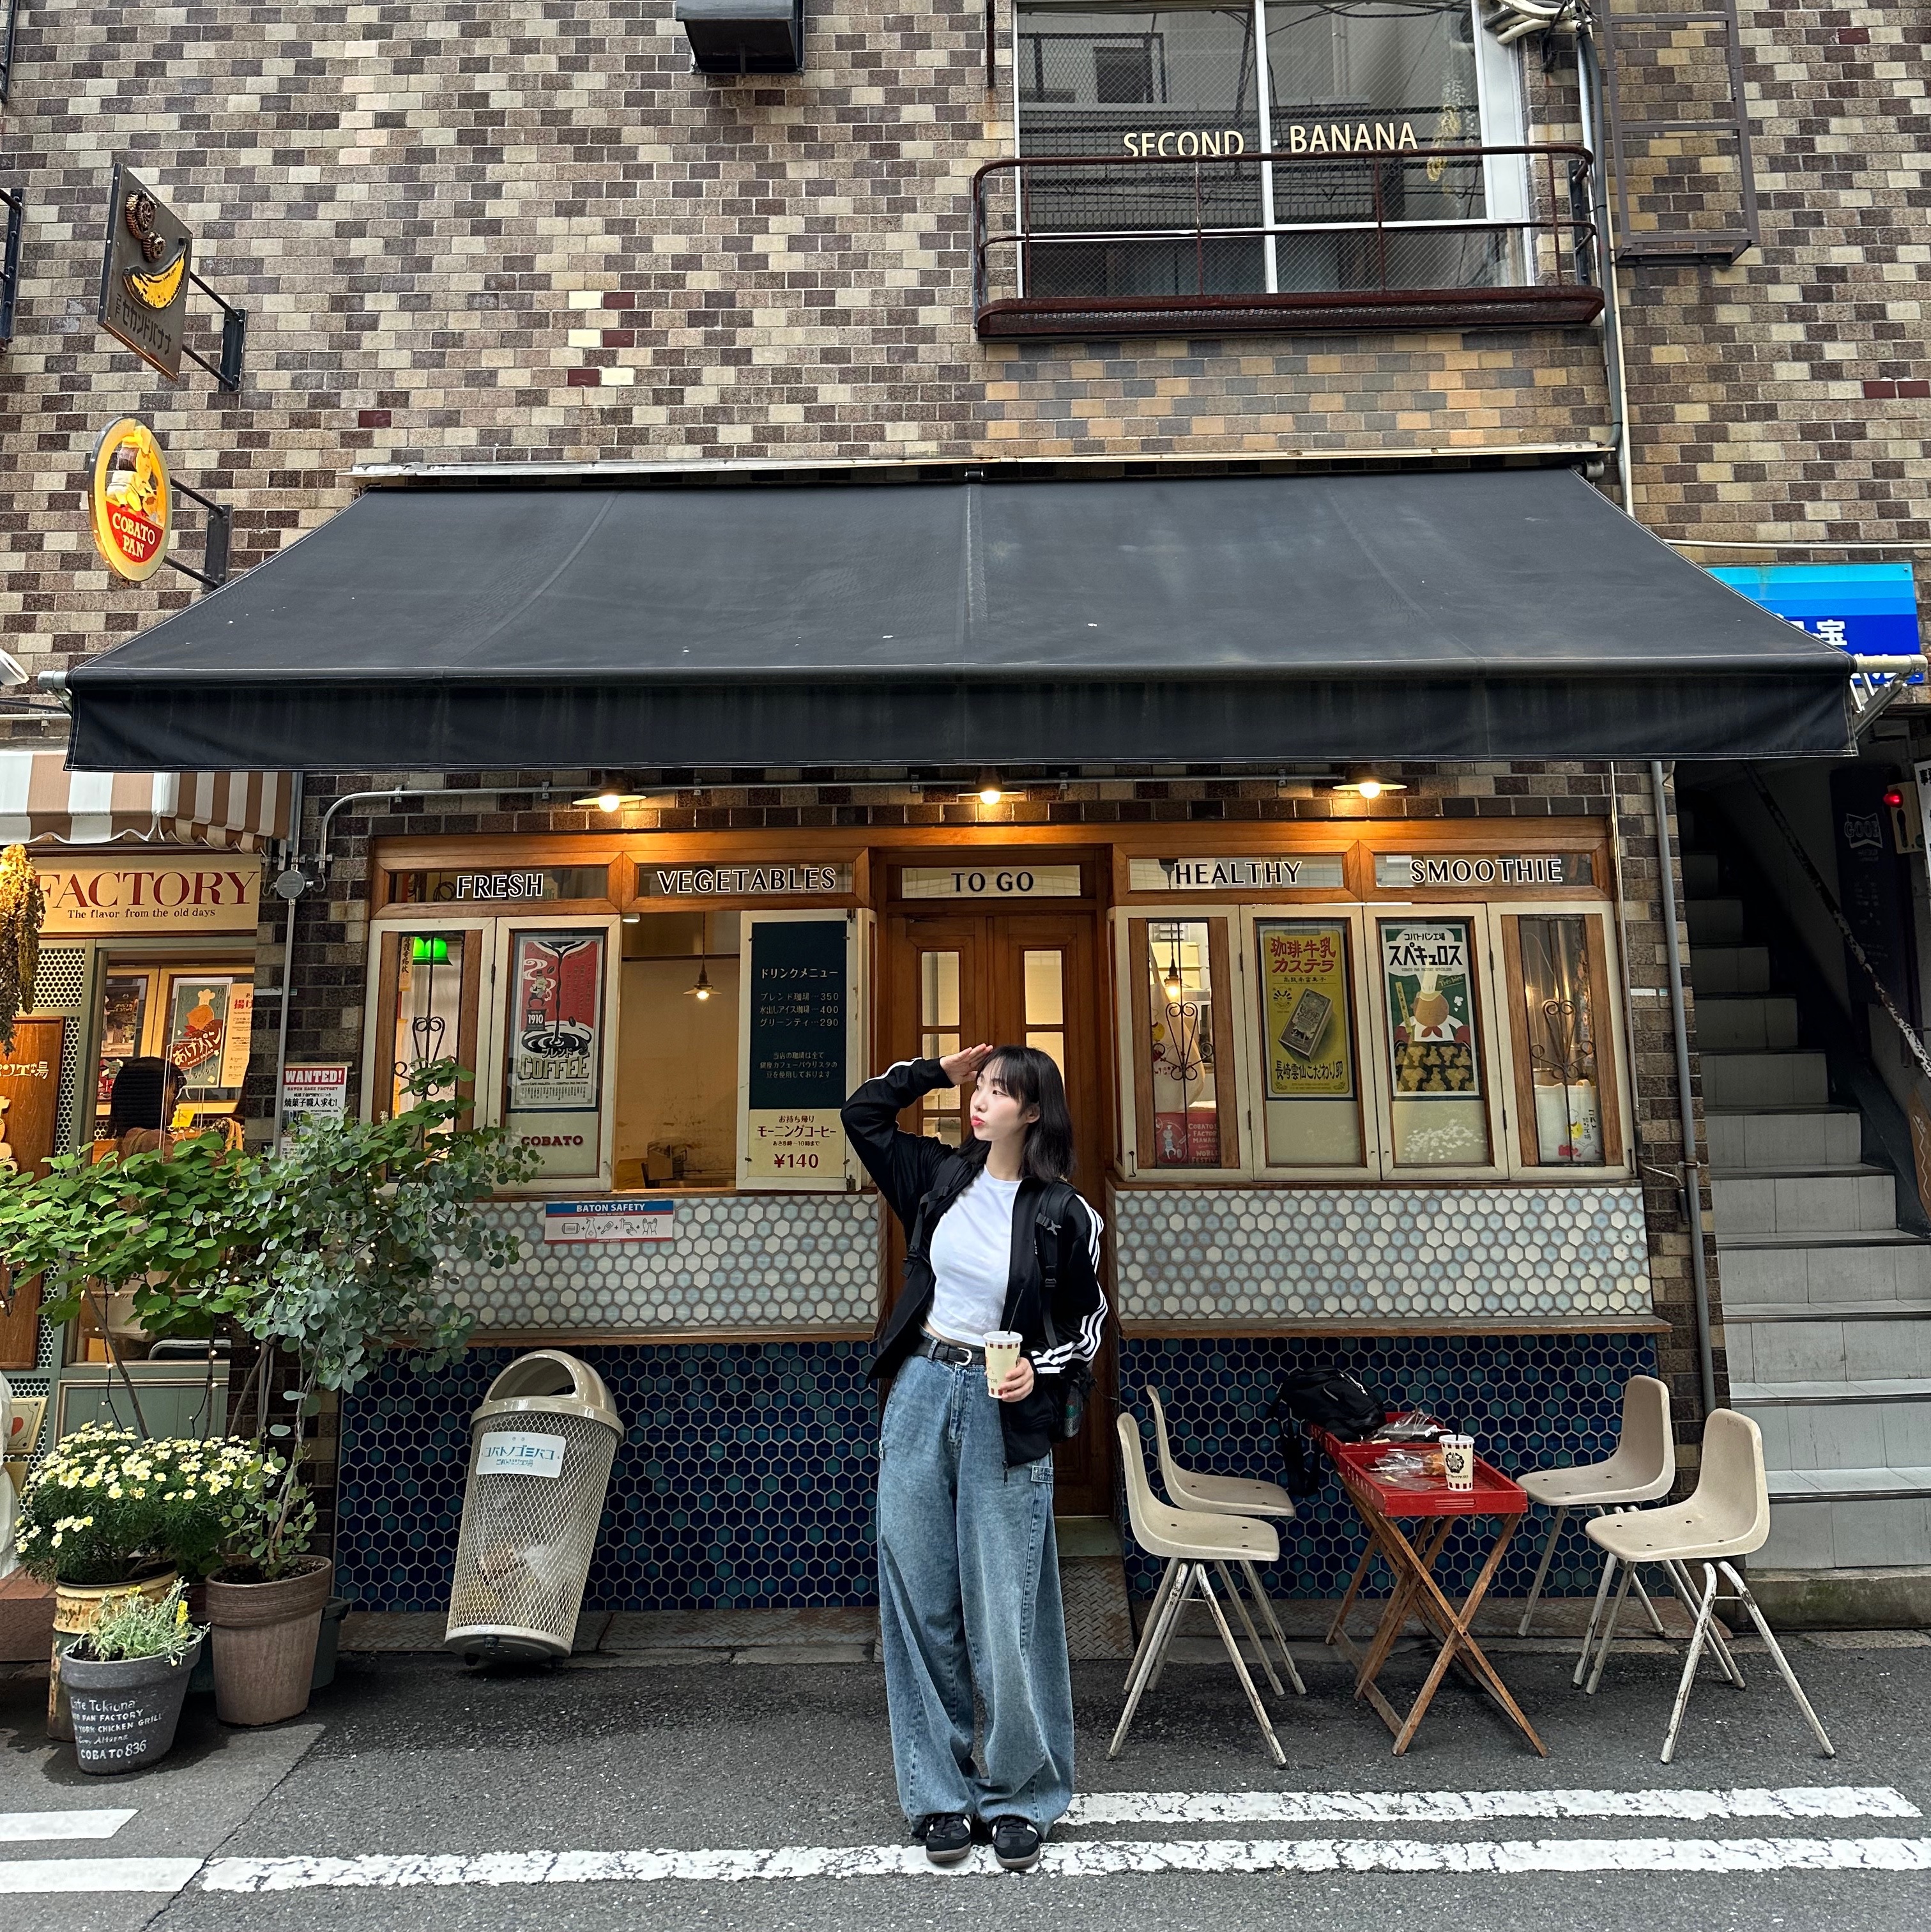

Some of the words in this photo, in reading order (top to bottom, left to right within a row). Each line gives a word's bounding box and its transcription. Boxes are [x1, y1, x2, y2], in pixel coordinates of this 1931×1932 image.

[1124, 130, 1244, 157] SECOND
[1290, 122, 1418, 153] BANANA
[123, 298, 172, 355] セカンドバナナ
[112, 512, 155, 545] COBATO
[123, 535, 144, 558] PAN
[657, 867, 836, 894] VEGETABLES
[1174, 861, 1302, 884] HEALTHY
[1410, 859, 1563, 883] SMOOTHIE
[34, 871, 259, 908] FACTORY
[456, 873, 544, 899] FRESH
[951, 872, 986, 893] TO
[996, 871, 1034, 892] GO
[68, 910, 86, 919] The
[91, 909, 119, 919] flavor
[125, 908, 149, 917] from
[153, 908, 169, 917] the
[174, 908, 189, 917] old
[192, 907, 215, 918] days
[1271, 936, 1336, 958] 珈琲牛乳
[1404, 933, 1446, 941] コバトパン工場
[1389, 942, 1463, 966] スペキュロス
[761, 968, 839, 979] ドリンクメニュー
[1271, 958, 1334, 973] カステラ
[760, 992, 810, 1001] ブレンド珈琲
[528, 1014, 544, 1024] 1910
[760, 1006, 810, 1015] 水出しアイス珈琲
[820, 1006, 839, 1014] 400
[760, 1018, 809, 1027] グリーンティ
[820, 1018, 839, 1027] 290
[172, 1027, 222, 1066] あげパン
[542, 1048, 573, 1058] ブレンド
[518, 1052, 590, 1080] COFFEE
[1276, 1060, 1343, 1080] 長崎雲仙こだわり卵
[285, 1070, 342, 1083] WANTED!
[521, 1135, 583, 1146] COBATO
[757, 1124, 836, 1138] モーニングコーヒー
[774, 1154, 819, 1168] ¥140
[576, 1204, 609, 1213] BATON
[611, 1203, 646, 1211] SAFETY
[484, 1445, 555, 1460] コバトノゴミバコ
[1347, 1465, 1374, 1501] COBATO
[79, 1725, 95, 1733] YORK
[98, 1722, 134, 1733] CHICKEN
[138, 1713, 162, 1726] GRILL
[100, 1708, 144, 1722] FACTORY
[80, 1749, 123, 1760] COBATO
[125, 1739, 147, 1757] 836
